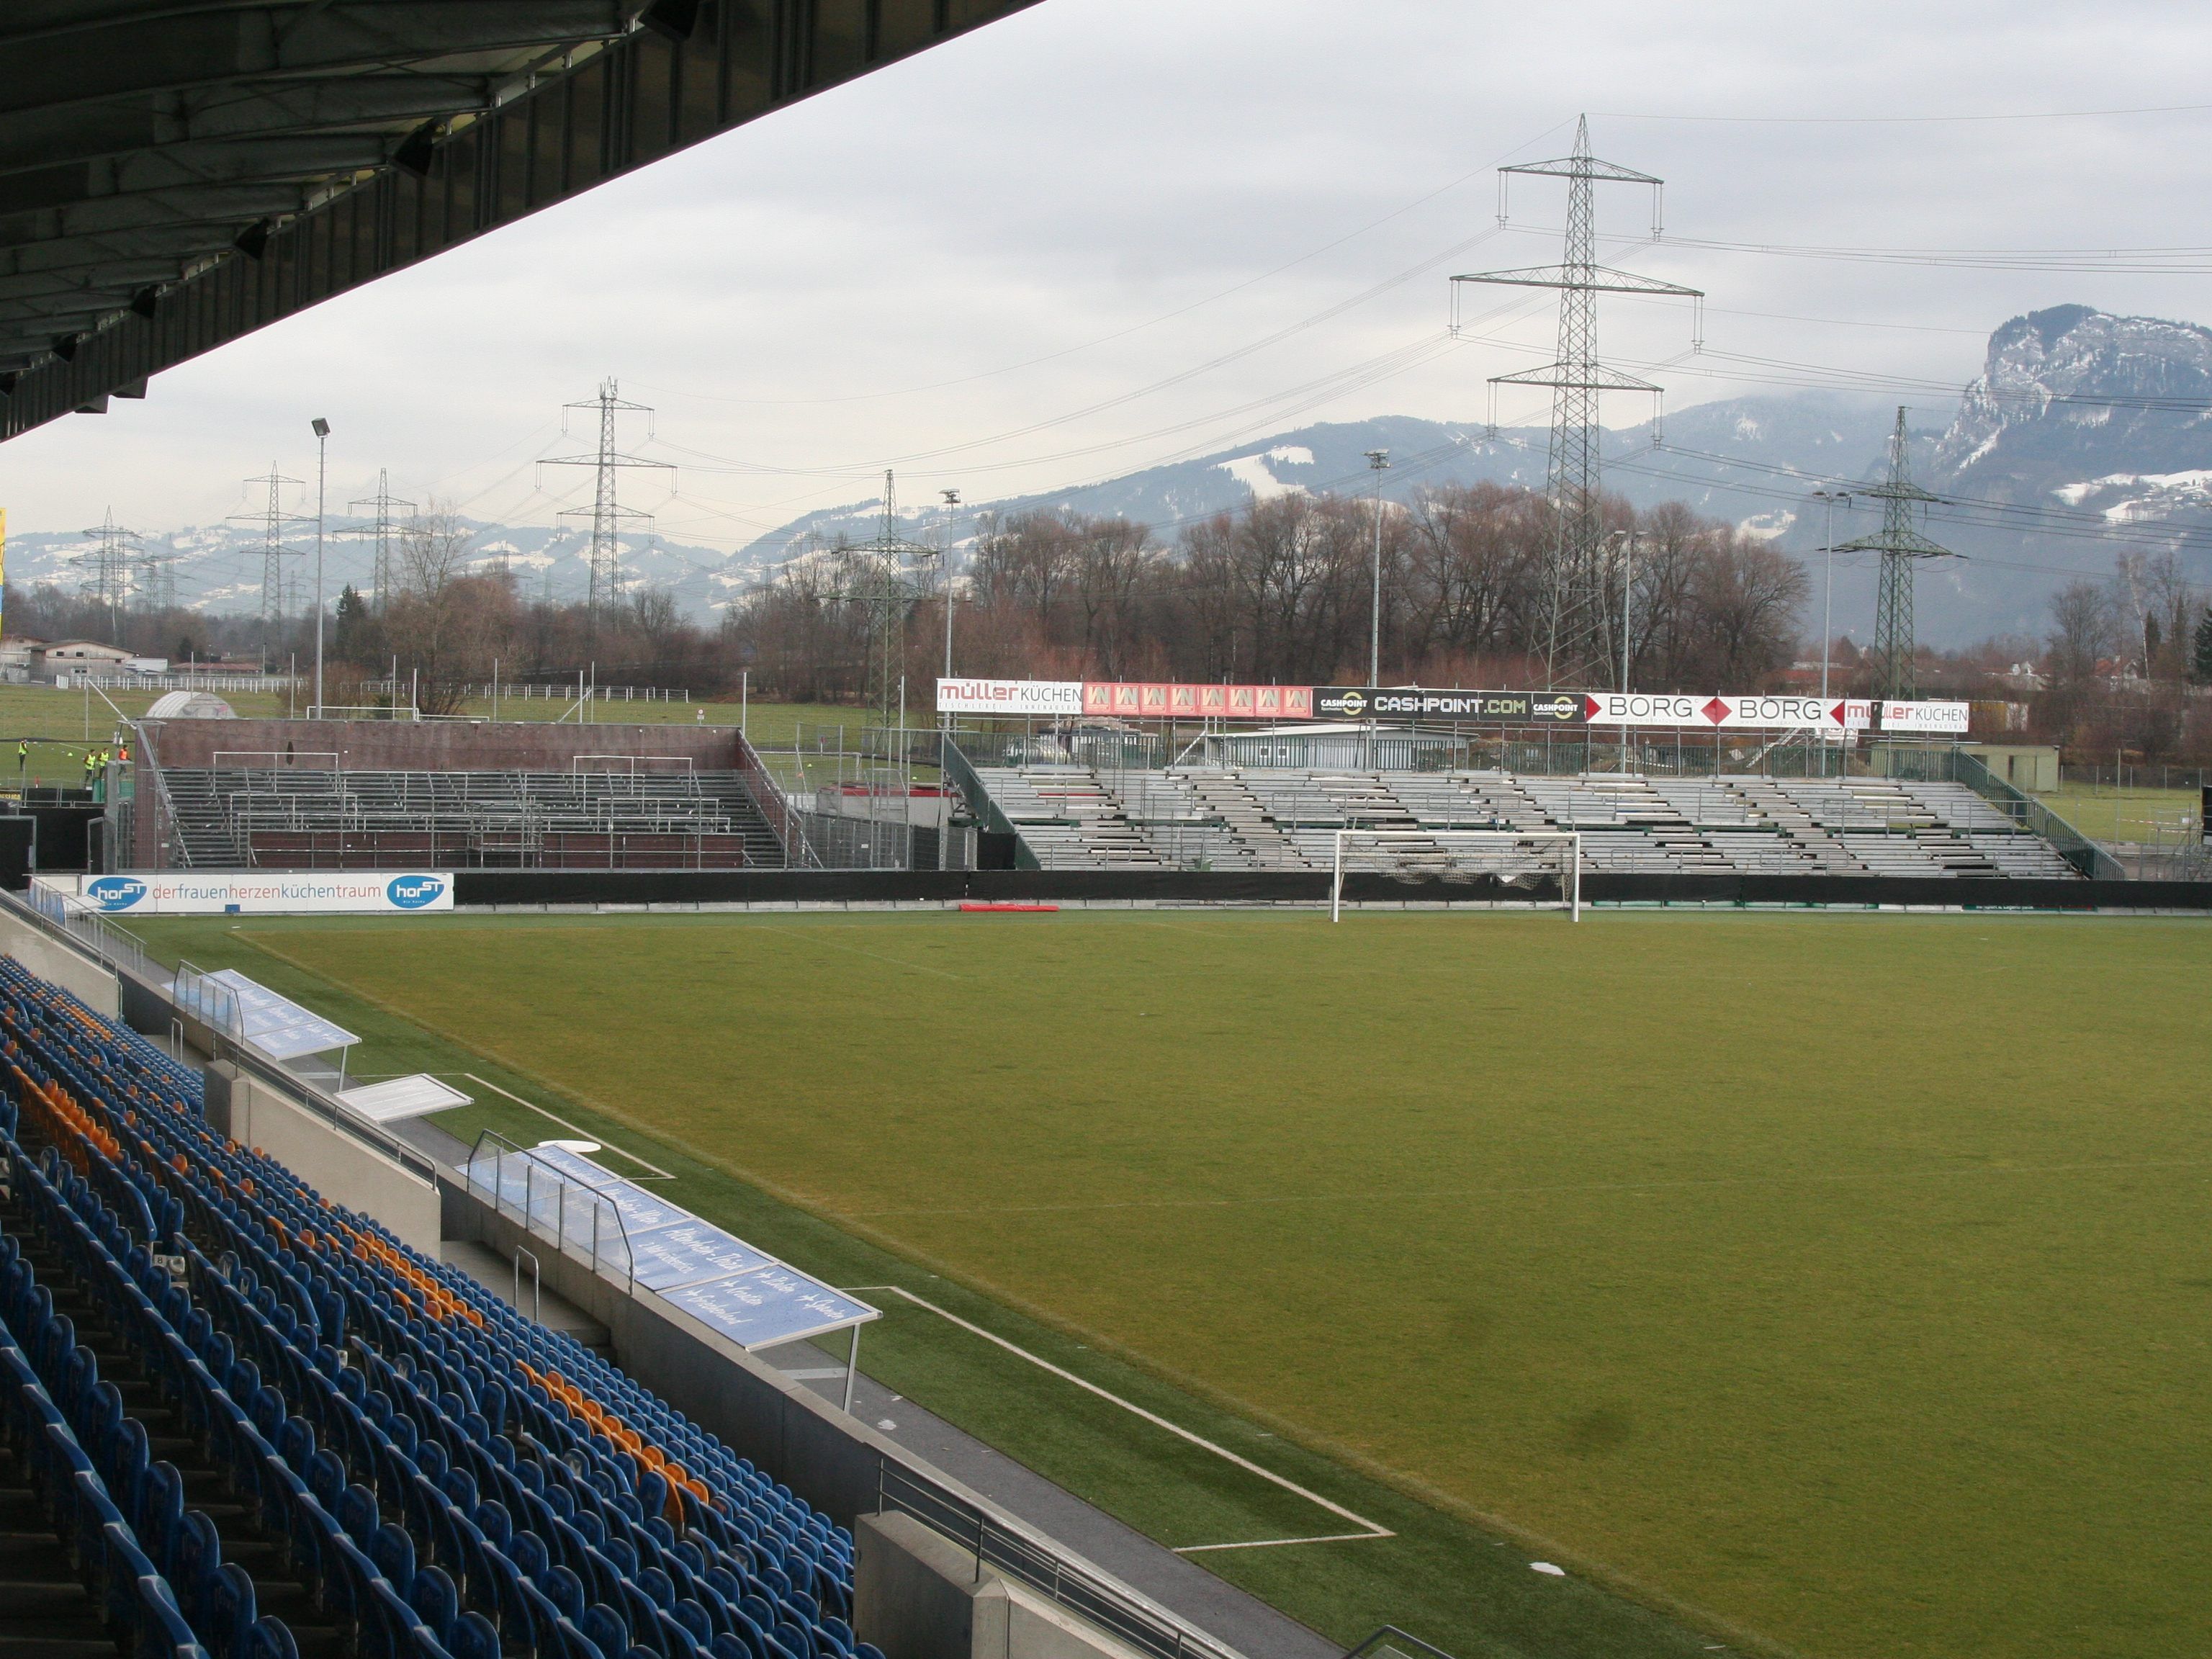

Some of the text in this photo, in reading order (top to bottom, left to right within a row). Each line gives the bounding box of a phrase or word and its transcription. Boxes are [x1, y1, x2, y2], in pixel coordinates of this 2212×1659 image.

[939, 683, 1082, 702] müller KÜCHEN
[1320, 699, 1368, 708] CASHPOINT
[1374, 696, 1526, 714] CASHPOINT.COM
[1533, 703, 1578, 712] CASHPOINT
[1609, 696, 1693, 718] BORG
[1740, 699, 1821, 720] BORG
[1915, 706, 1967, 721] KÜCHEN
[153, 883, 381, 899] derfrauenherzenküchentraum
